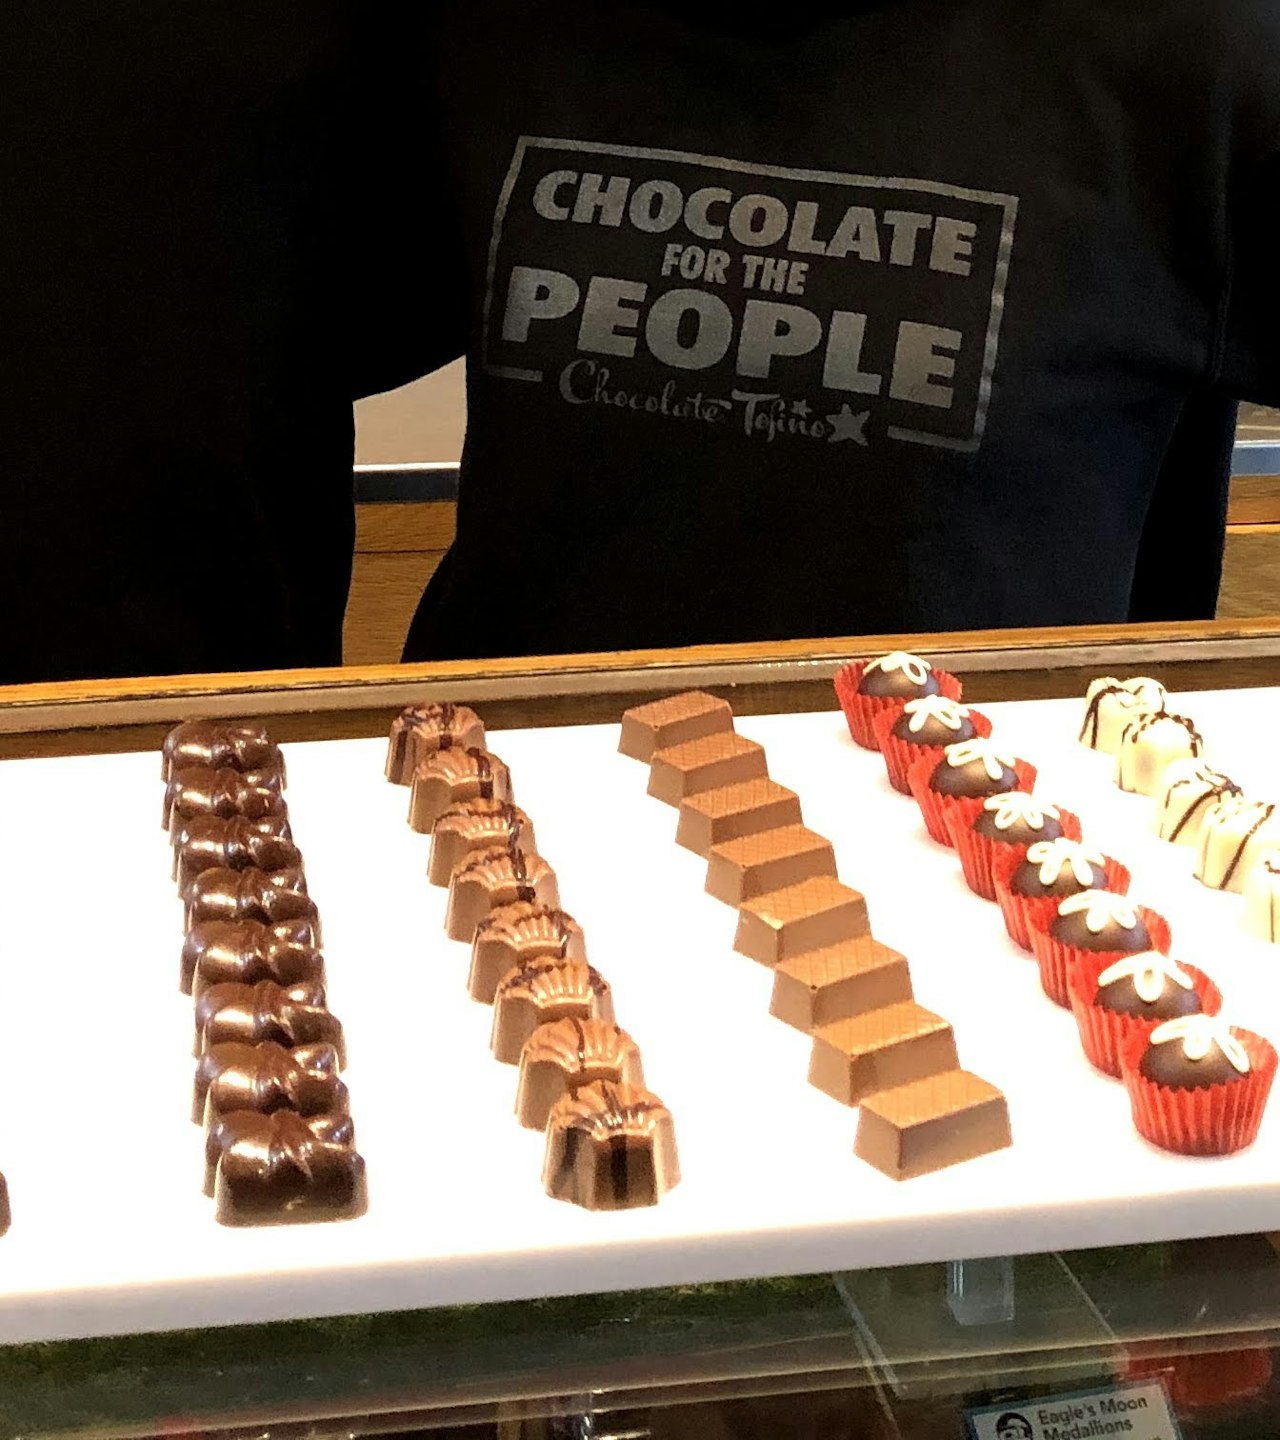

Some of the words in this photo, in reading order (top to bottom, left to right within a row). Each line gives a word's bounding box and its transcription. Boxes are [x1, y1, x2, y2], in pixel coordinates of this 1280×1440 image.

[532, 170, 978, 276] CHOCOLATE
[660, 244, 731, 285] FOR
[742, 254, 810, 296] THE
[501, 266, 963, 409] PEOPLE
[558, 360, 733, 425] Chocolate
[730, 389, 827, 444] Tofino
[1039, 1403, 1097, 1426] Eagle's
[1099, 1395, 1149, 1414] Moon
[1043, 1417, 1134, 1440] Medallions
